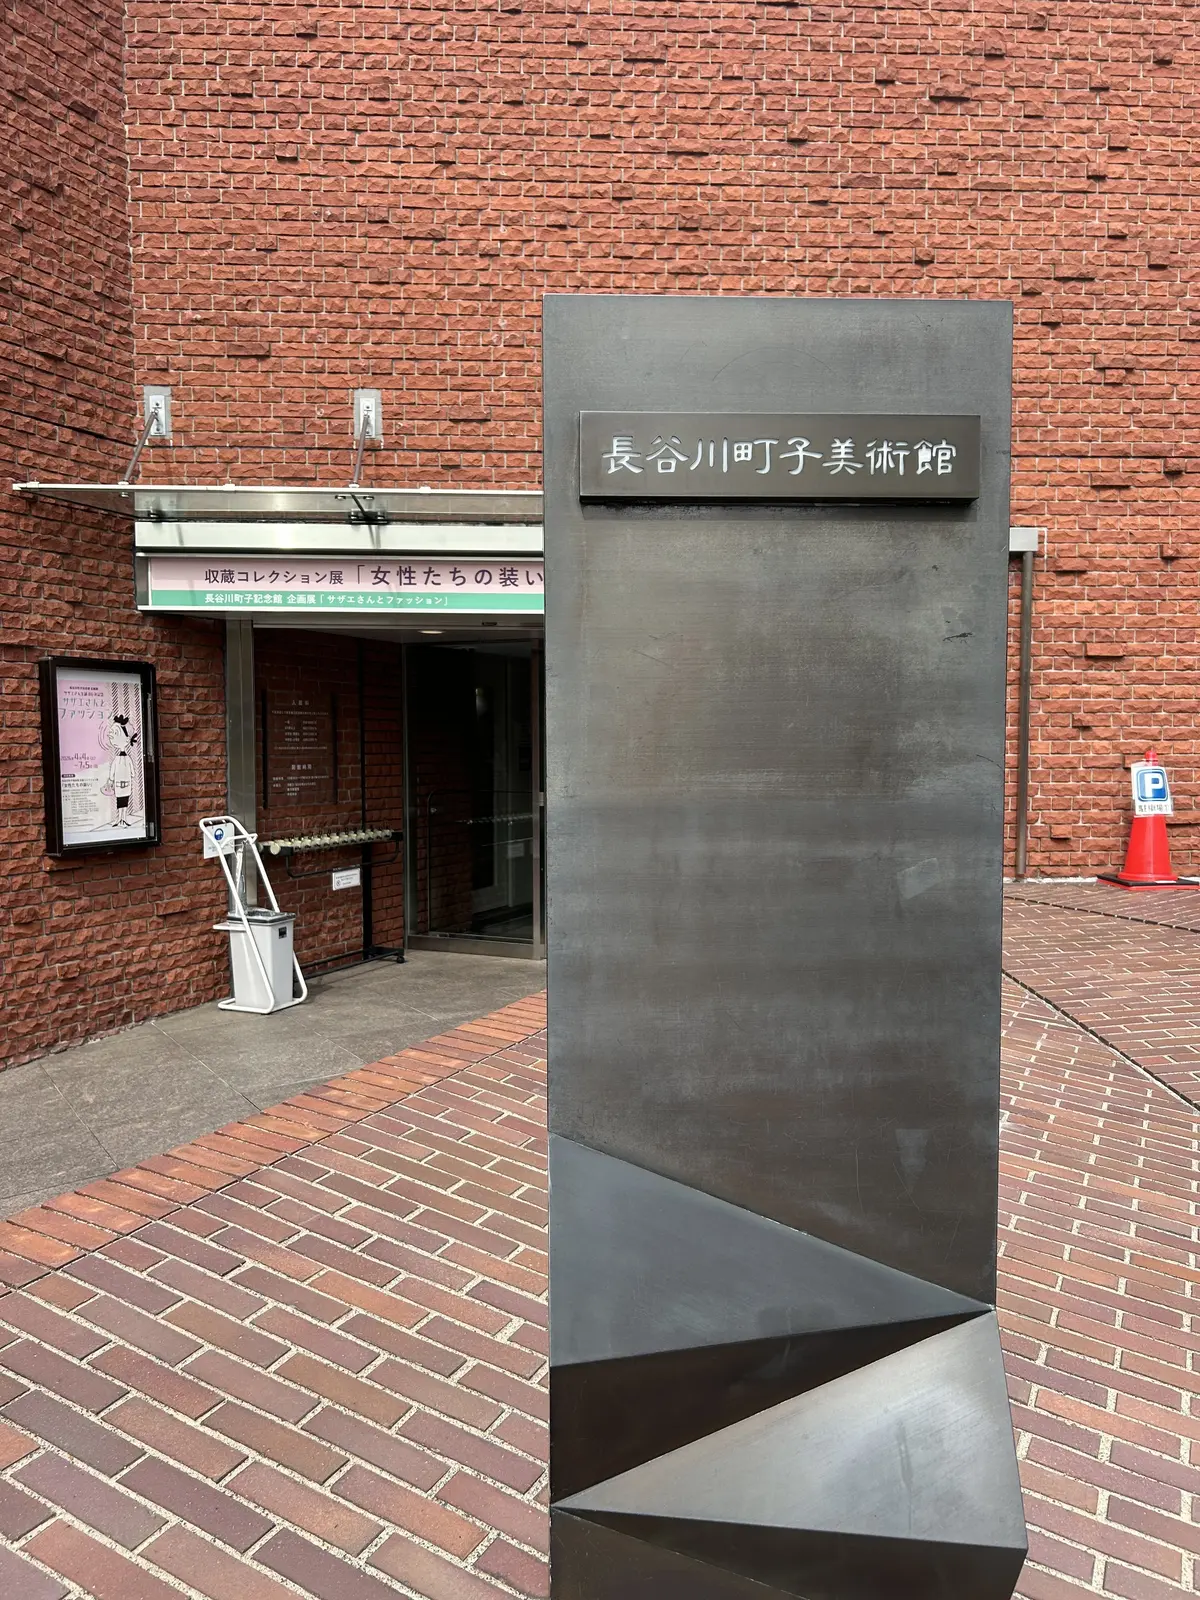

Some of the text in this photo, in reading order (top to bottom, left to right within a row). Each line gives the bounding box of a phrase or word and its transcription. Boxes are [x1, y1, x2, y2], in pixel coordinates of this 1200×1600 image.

[602, 435, 958, 476] 長谷川町子美術館
[204, 592, 283, 605] 長谷川町子記念館
[1144, 772, 1164, 798] P
